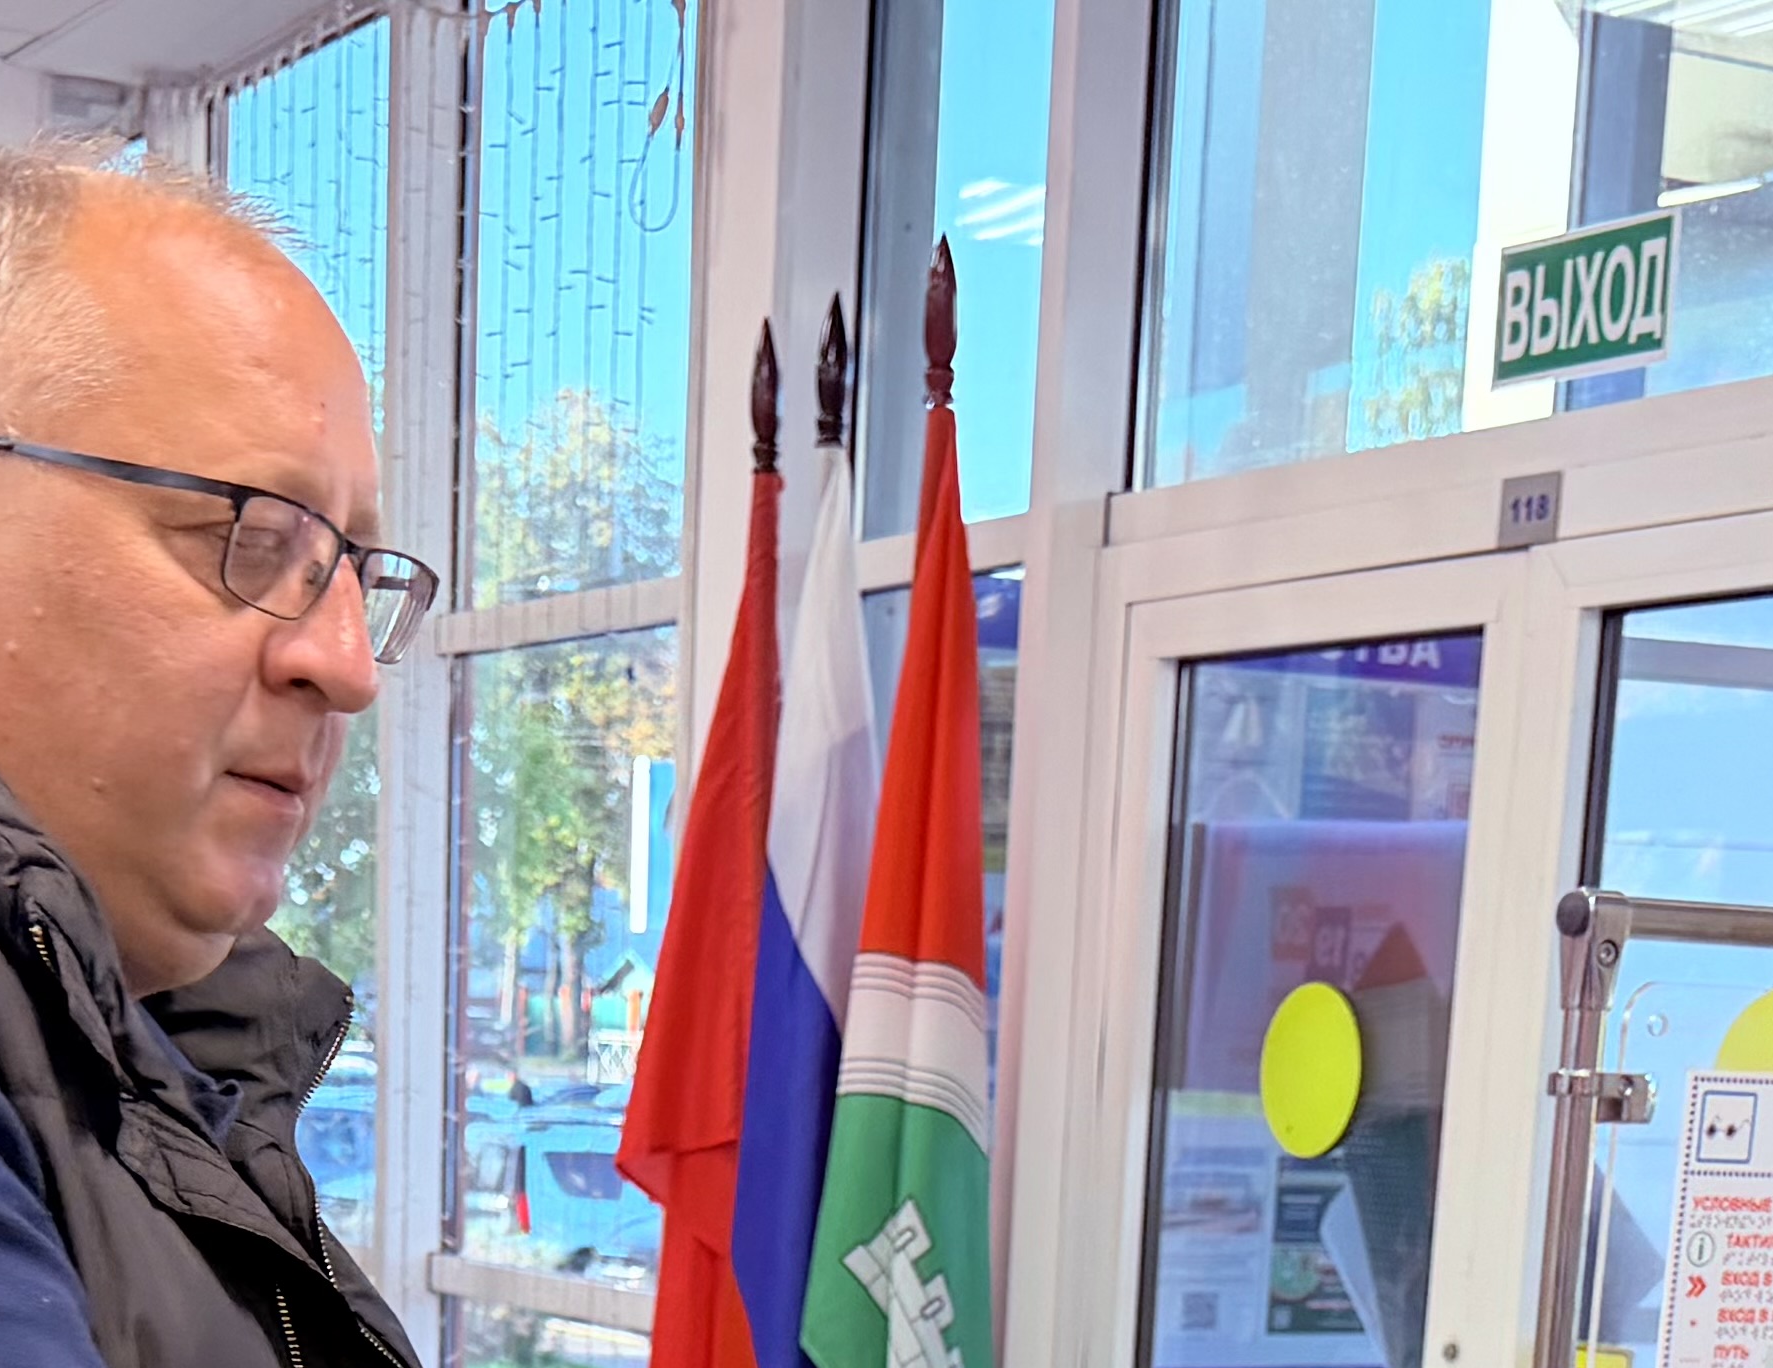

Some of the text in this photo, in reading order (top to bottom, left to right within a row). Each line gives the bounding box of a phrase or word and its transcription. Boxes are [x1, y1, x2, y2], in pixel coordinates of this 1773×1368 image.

[1501, 237, 1668, 362] ВЫХОД
[1692, 1196, 1773, 1213] УСЛОВНЫЕ
[1721, 1271, 1760, 1288] ВХОД
[1717, 1307, 1756, 1324] ВХОД
[1713, 1344, 1750, 1360] ПУТЬ
